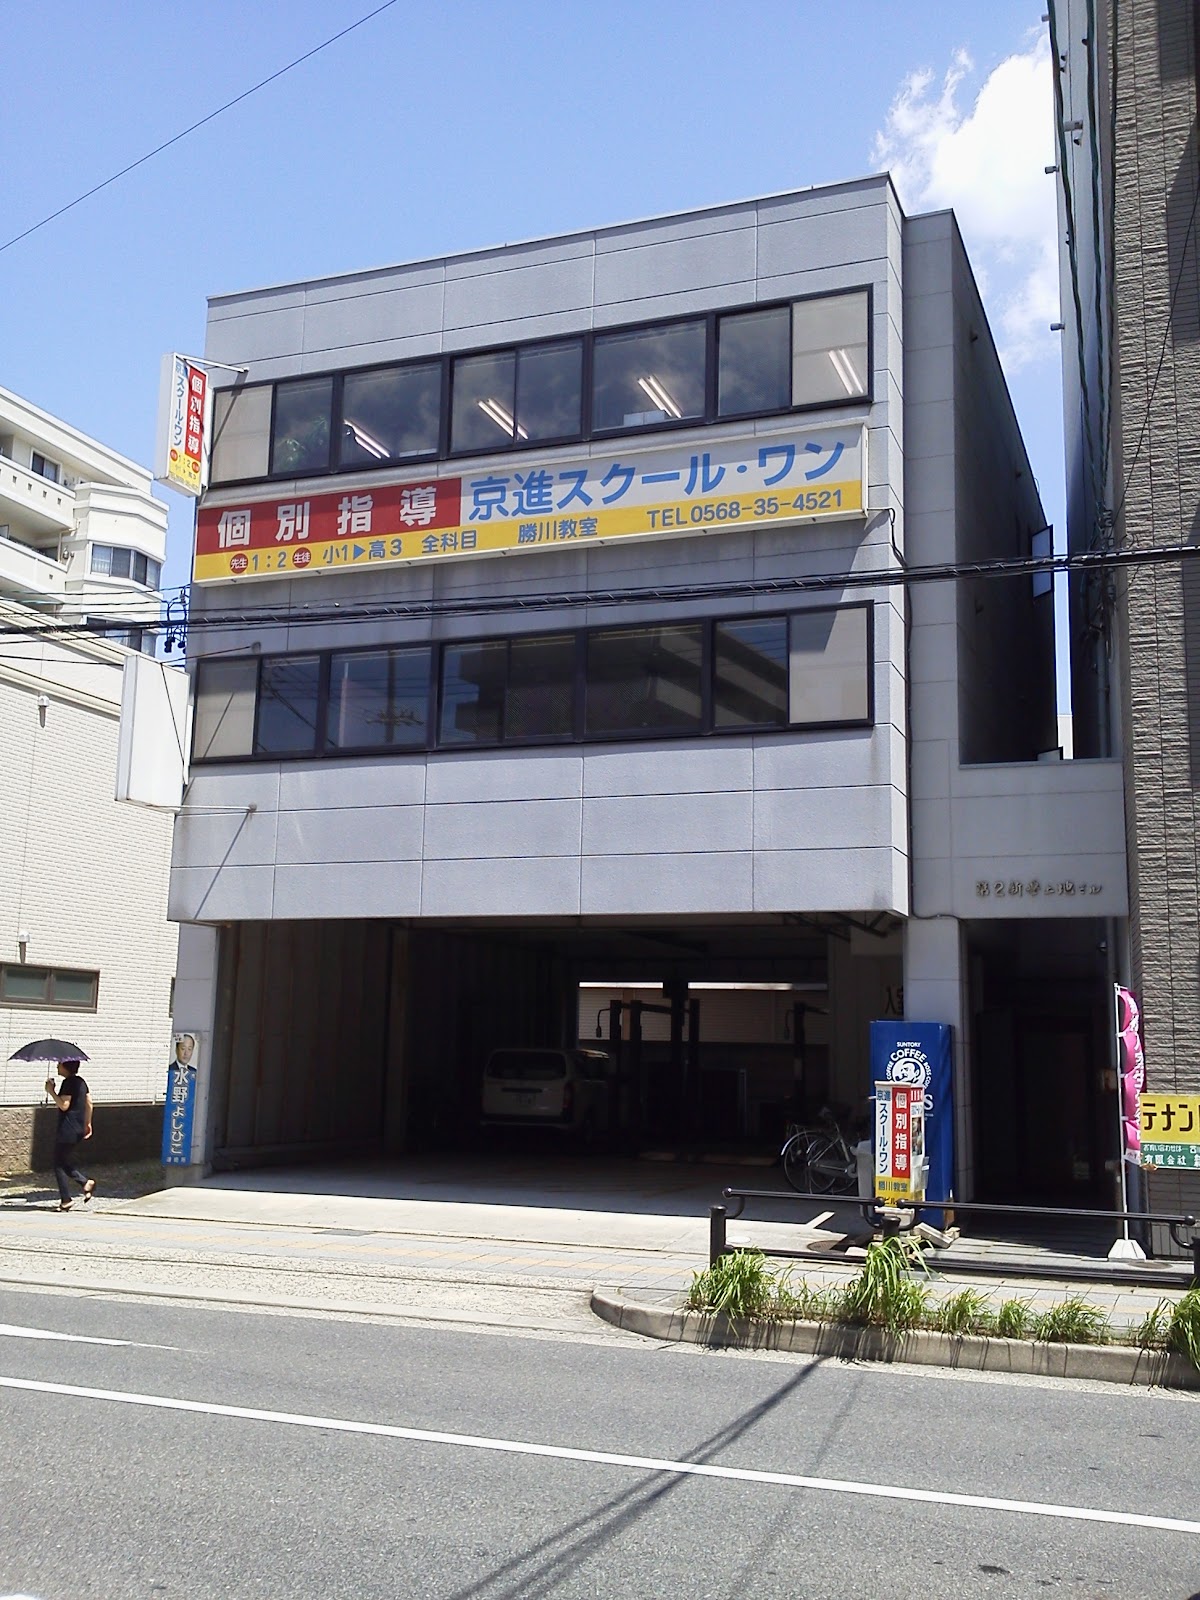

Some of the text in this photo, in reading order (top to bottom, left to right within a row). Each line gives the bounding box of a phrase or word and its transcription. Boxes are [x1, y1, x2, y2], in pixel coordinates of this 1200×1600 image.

[187, 374, 203, 454] 個別指導
[469, 442, 845, 521] 京進スクール・ワン
[217, 486, 437, 548] 個別指導
[230, 557, 248, 570] 先生
[293, 552, 311, 565] 生徒
[421, 530, 477, 554] 全科目
[518, 517, 598, 544] 勝川教室
[890, 1048, 928, 1062] COFFEE
[170, 1068, 189, 1154] 水野よしひこ
[879, 1103, 888, 1174] スクール・ワン
[895, 1092, 908, 1170] 個別指導
[1142, 1103, 1200, 1132] テナン
[1144, 1154, 1186, 1165] 有限会社
